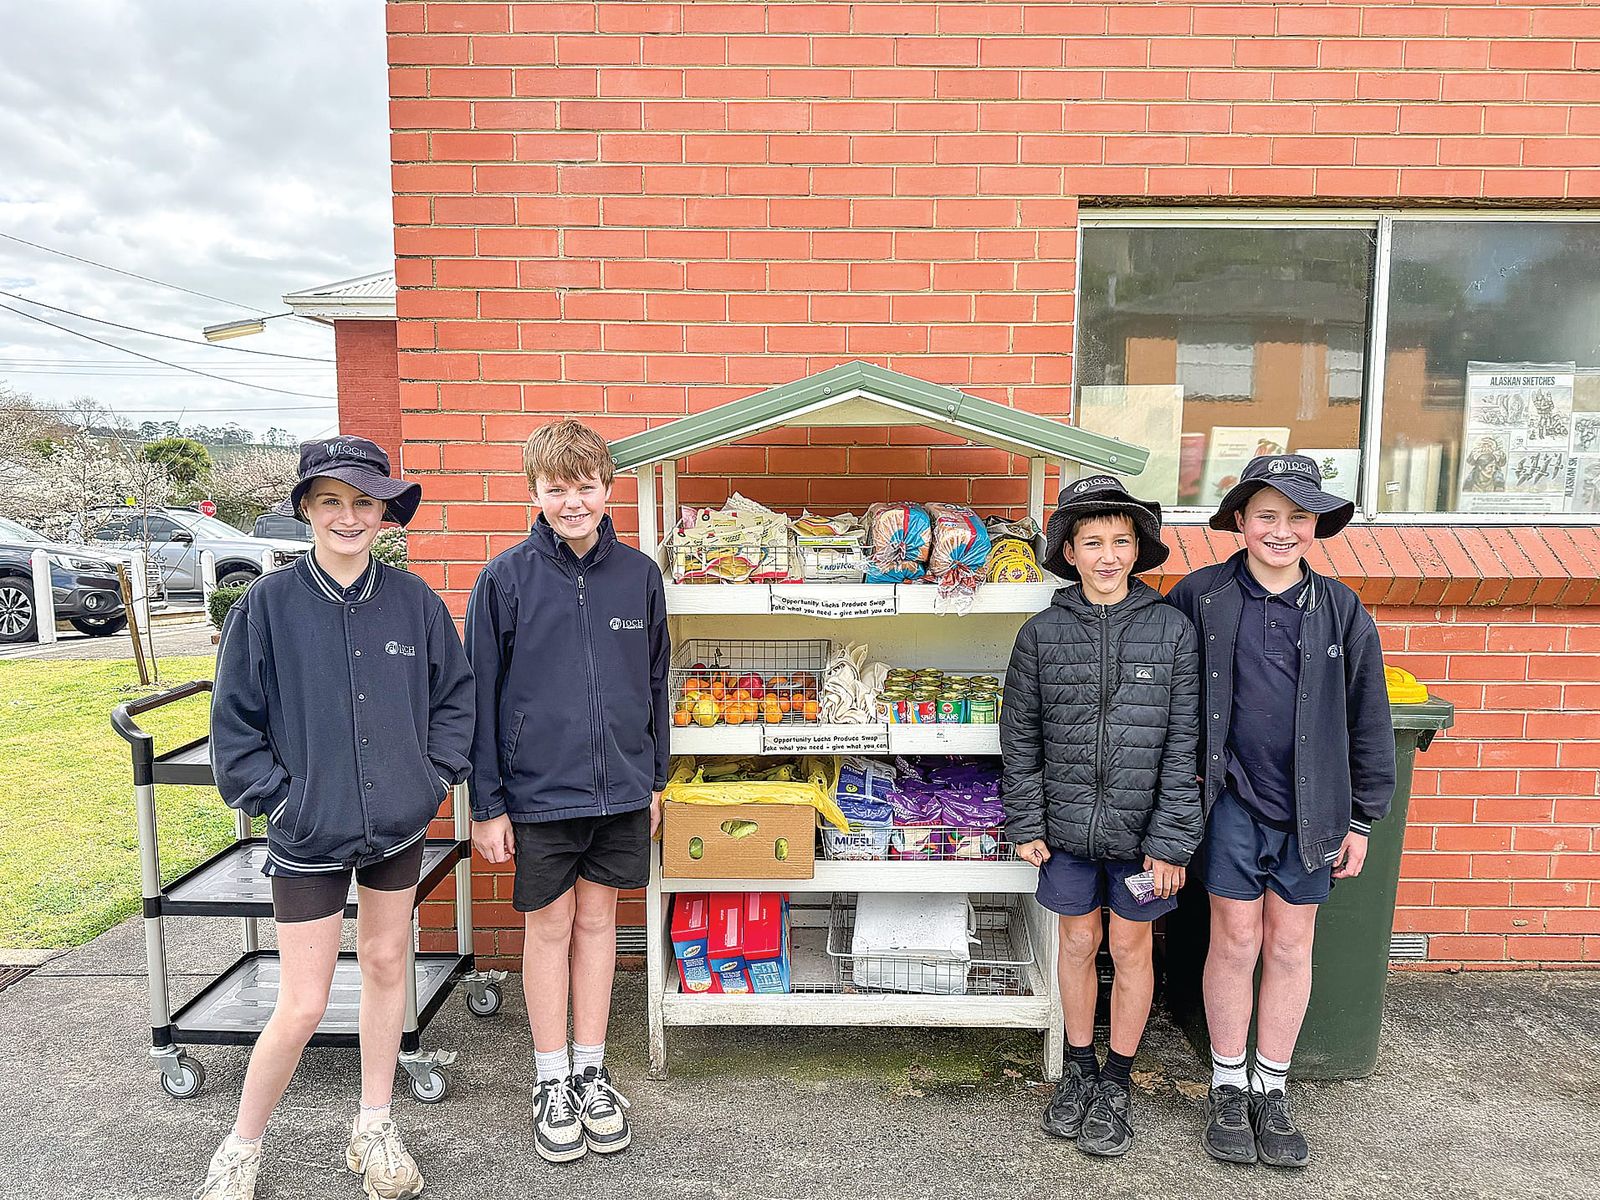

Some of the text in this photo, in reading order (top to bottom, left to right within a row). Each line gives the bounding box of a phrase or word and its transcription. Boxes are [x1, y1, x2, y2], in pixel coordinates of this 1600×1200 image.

[1490, 376, 1556, 386] ALASKAN SKETCHES
[338, 444, 367, 459] LOCH
[1287, 461, 1312, 475] LOCH
[1565, 467, 1577, 498] ALASKAN
[200, 505, 215, 513] STOP
[782, 597, 819, 608] Opportunity
[842, 600, 867, 608] Produce
[869, 599, 886, 607] Swap
[839, 609, 852, 617] give
[870, 608, 882, 616] you
[622, 619, 644, 629] LOCH
[773, 736, 811, 744] Opportunity
[796, 744, 807, 752] you
